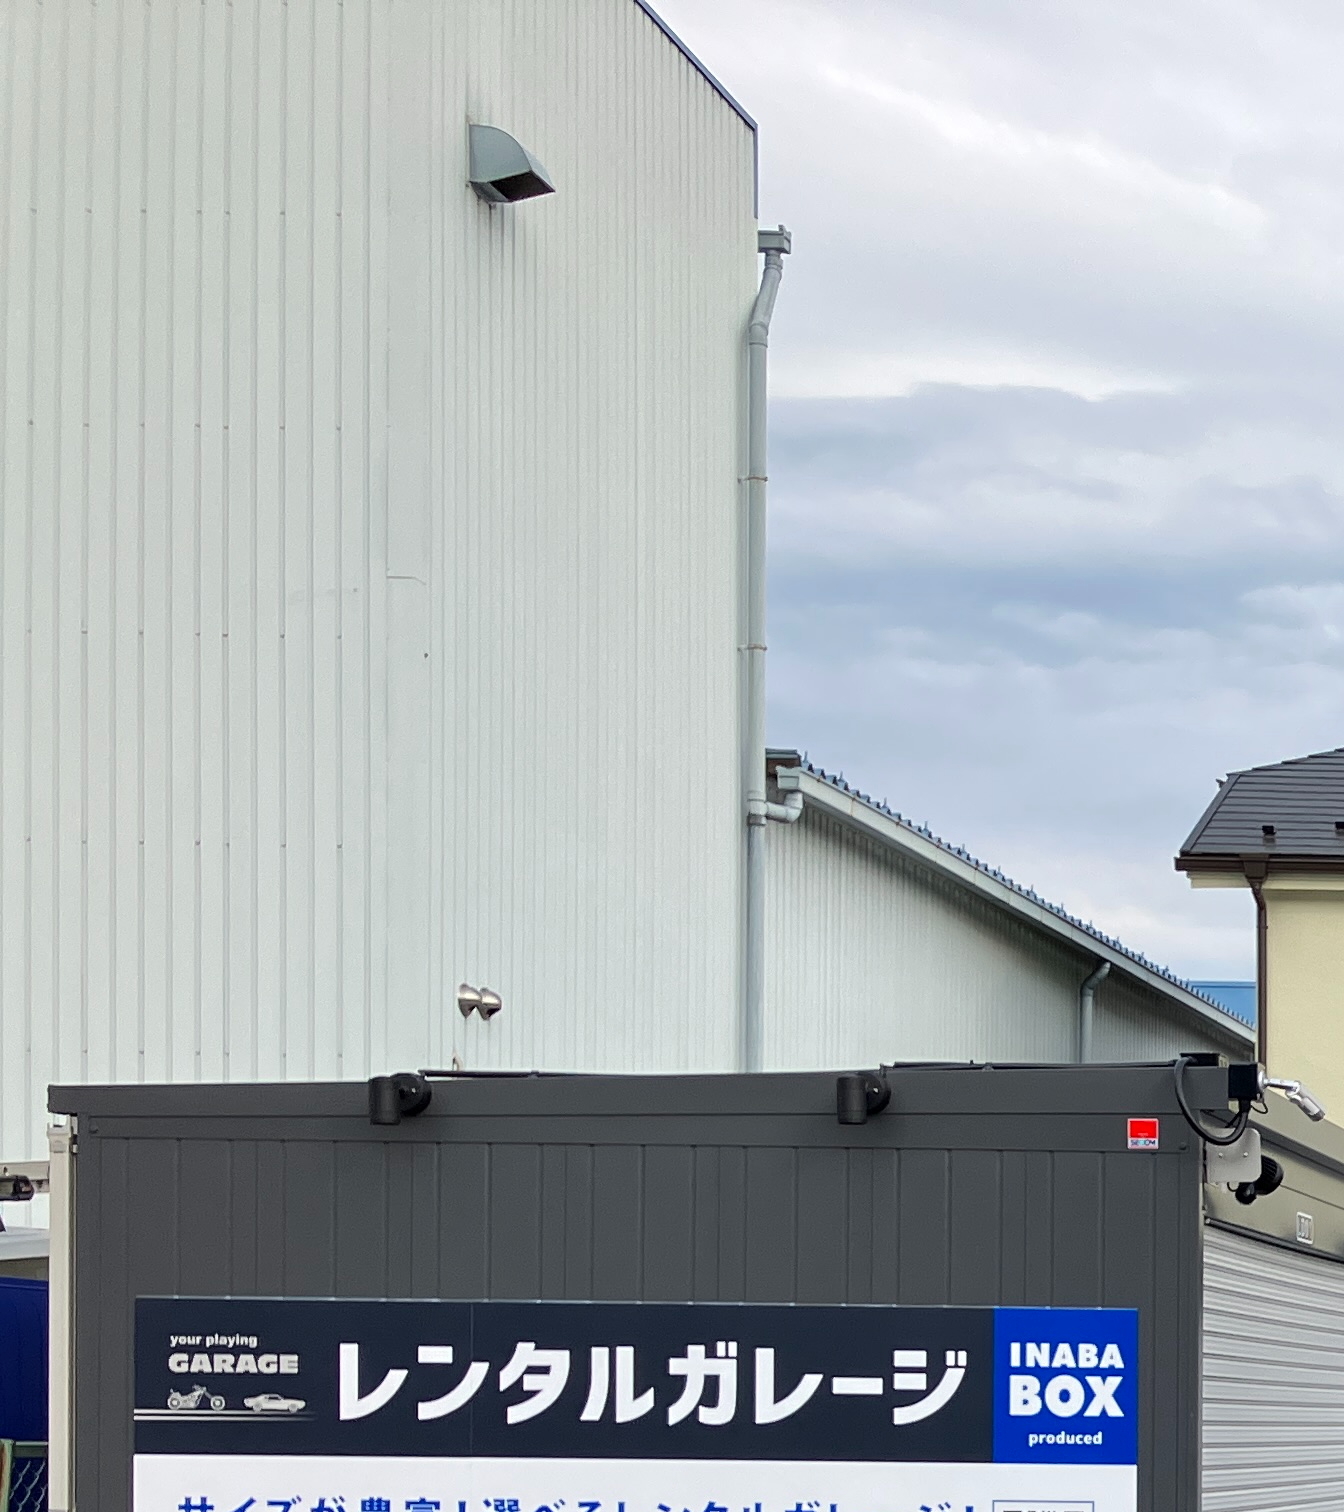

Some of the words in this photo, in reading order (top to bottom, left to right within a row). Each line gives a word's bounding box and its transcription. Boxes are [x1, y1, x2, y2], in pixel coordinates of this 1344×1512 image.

[170, 1335, 202, 1347] your
[205, 1333, 258, 1348] playing
[168, 1353, 299, 1374] GARAGE
[1009, 1341, 1124, 1369] INABA
[338, 1340, 968, 1426] レンタルガレージ
[1009, 1374, 1124, 1418] BOX
[1028, 1431, 1103, 1448] produced
